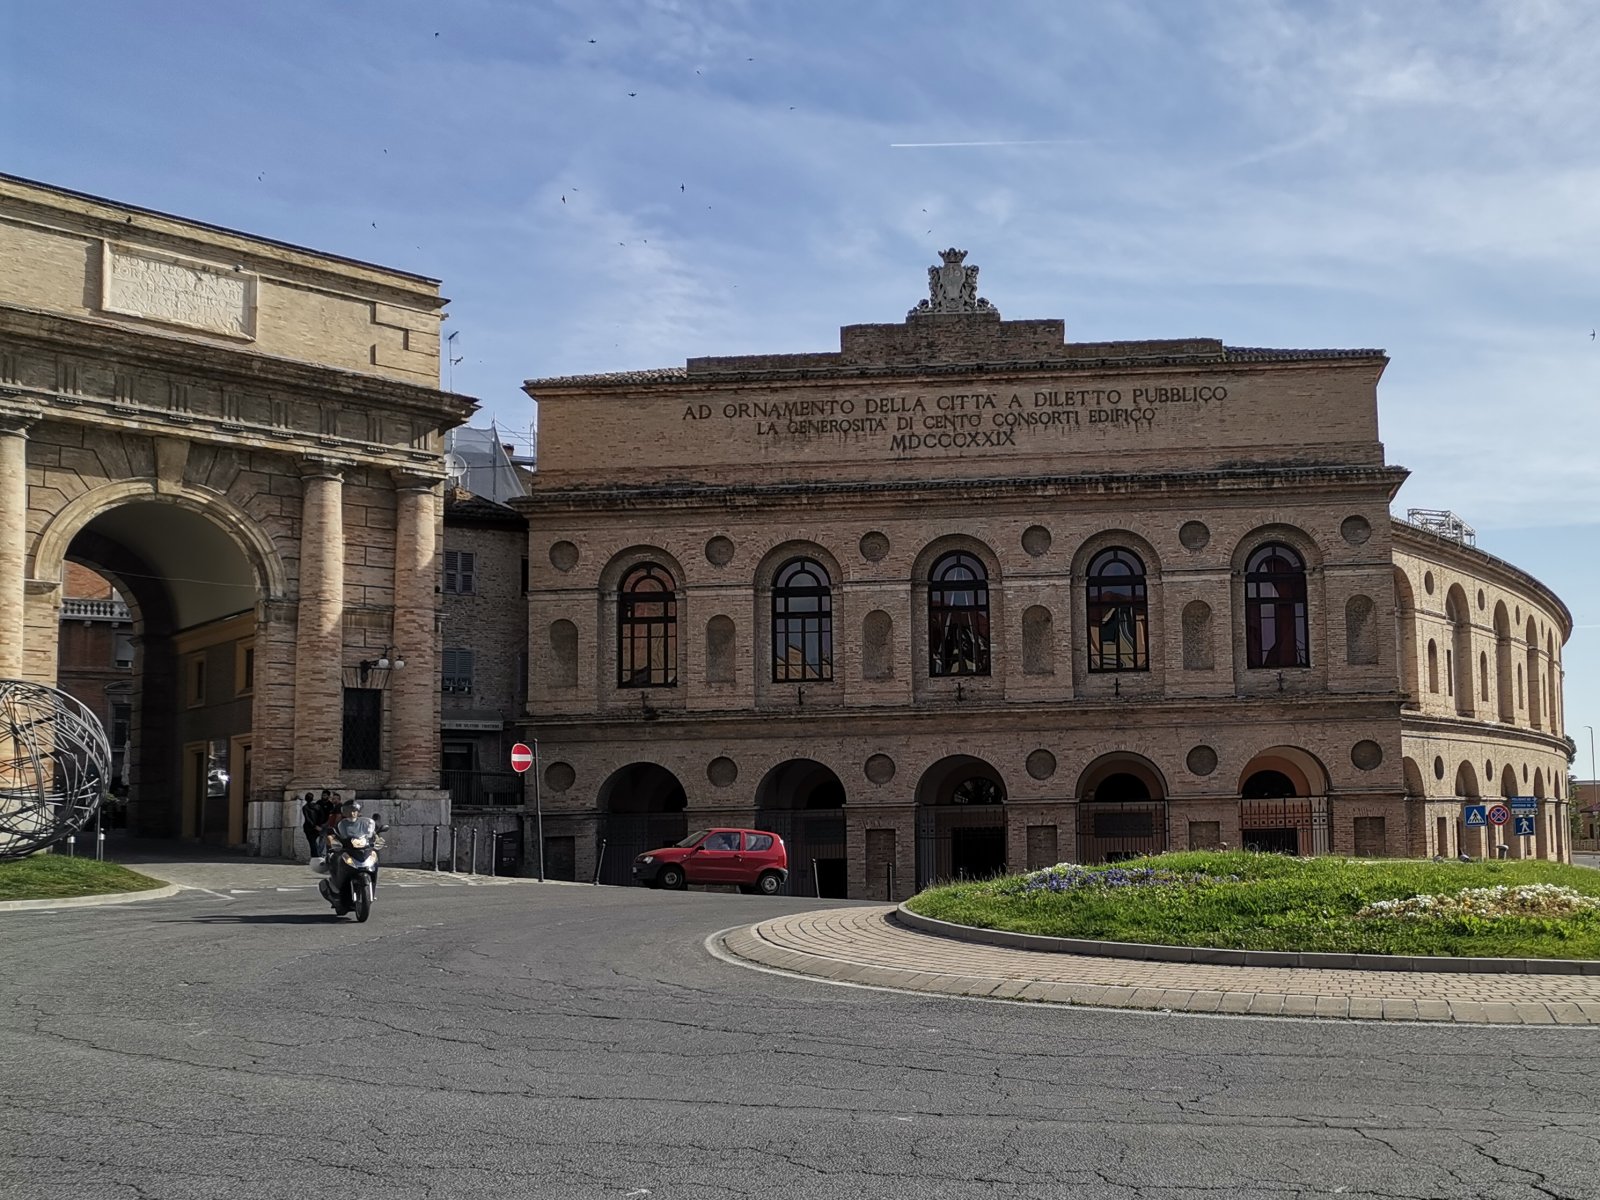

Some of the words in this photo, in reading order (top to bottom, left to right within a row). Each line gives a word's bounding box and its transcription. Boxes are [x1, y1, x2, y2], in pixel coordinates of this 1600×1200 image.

[682, 404, 712, 420] AD
[723, 400, 855, 420] ORNAMENTO
[865, 397, 926, 414] DELLA
[1008, 393, 1023, 409] A
[1033, 390, 1122, 408] DILETTO
[1132, 386, 1228, 404] PUBBLICO
[756, 421, 779, 436] LA
[896, 416, 914, 431] DI
[923, 413, 981, 431] CENTO
[992, 410, 1080, 428] CONSORTI
[889, 429, 1016, 452] MDCCCXXIX
